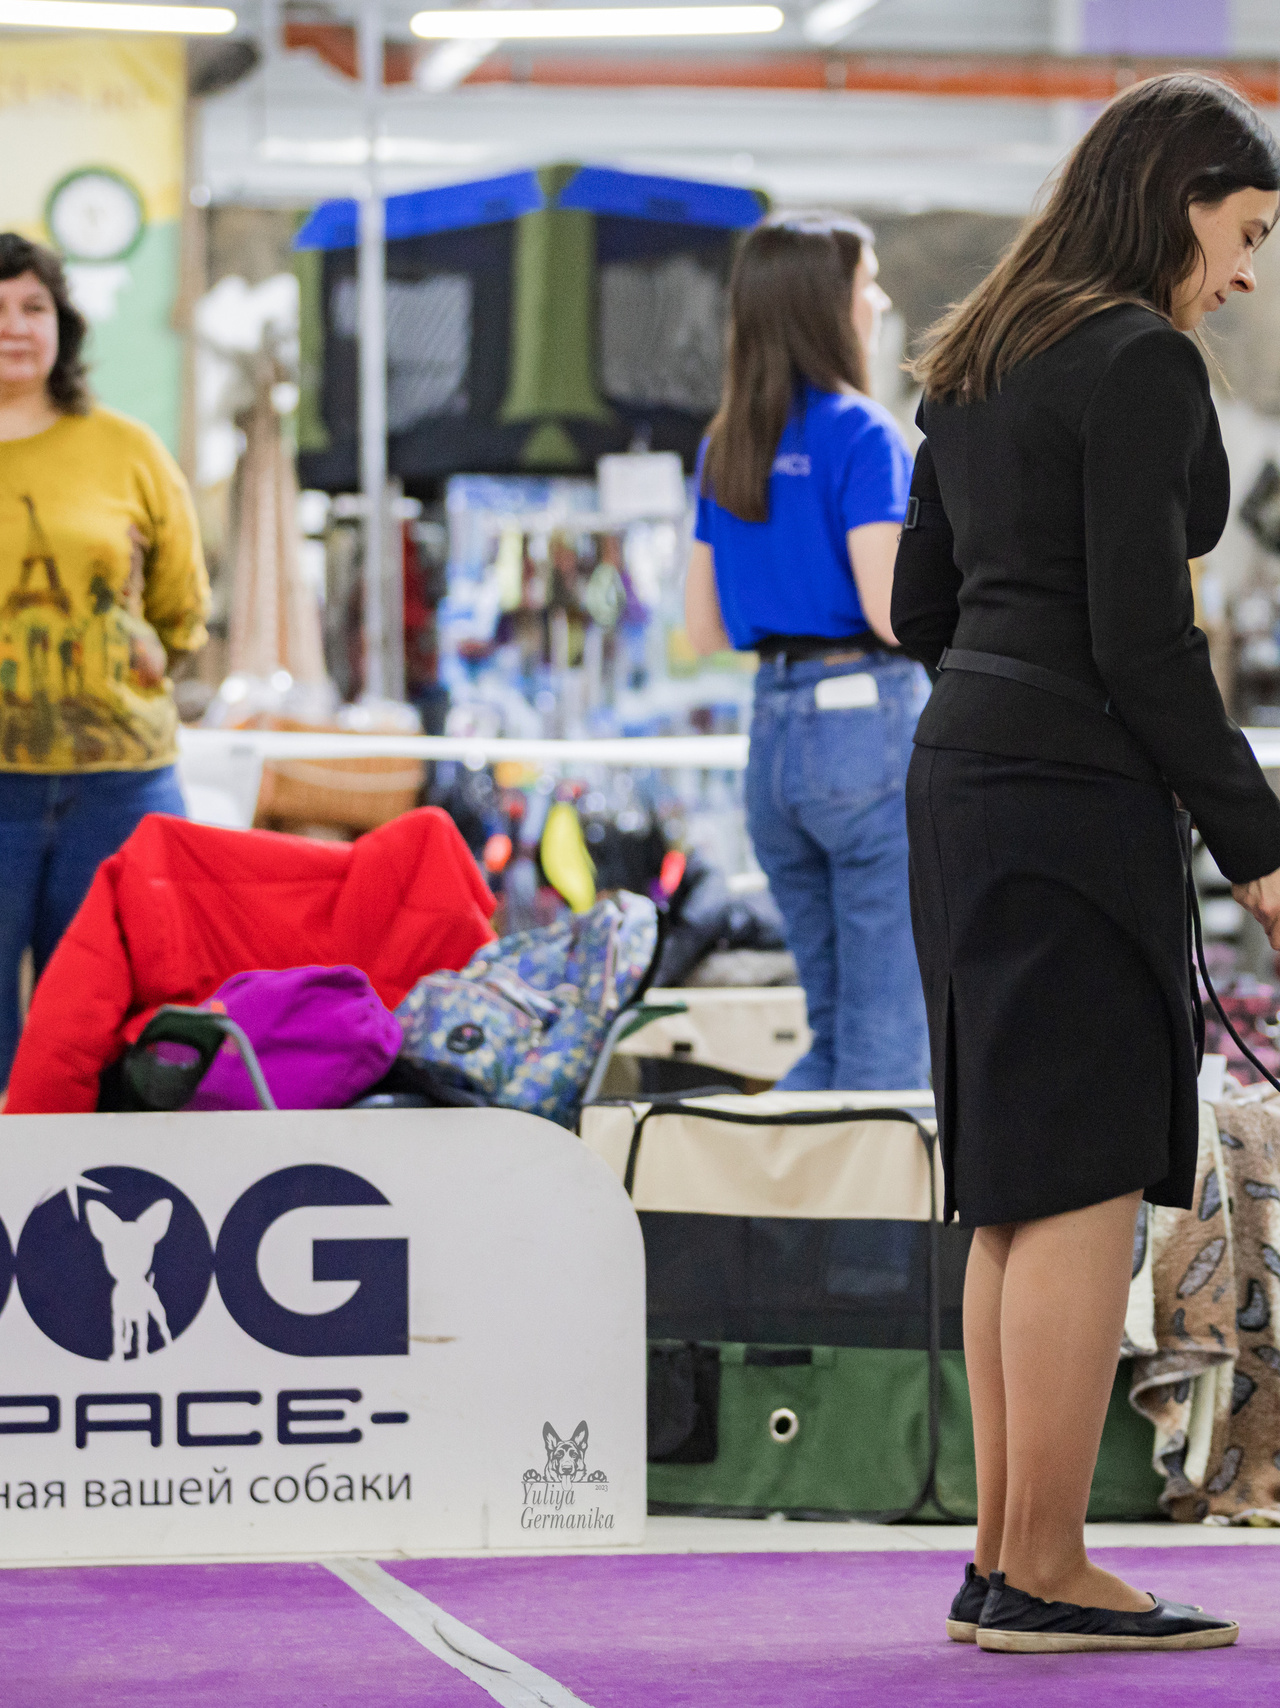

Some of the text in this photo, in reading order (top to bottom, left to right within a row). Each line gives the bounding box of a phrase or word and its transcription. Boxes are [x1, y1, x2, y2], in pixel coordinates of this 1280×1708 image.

[0, 1164, 409, 1359] OG
[85, 1466, 232, 1507] вашей
[250, 1463, 411, 1503] собаки
